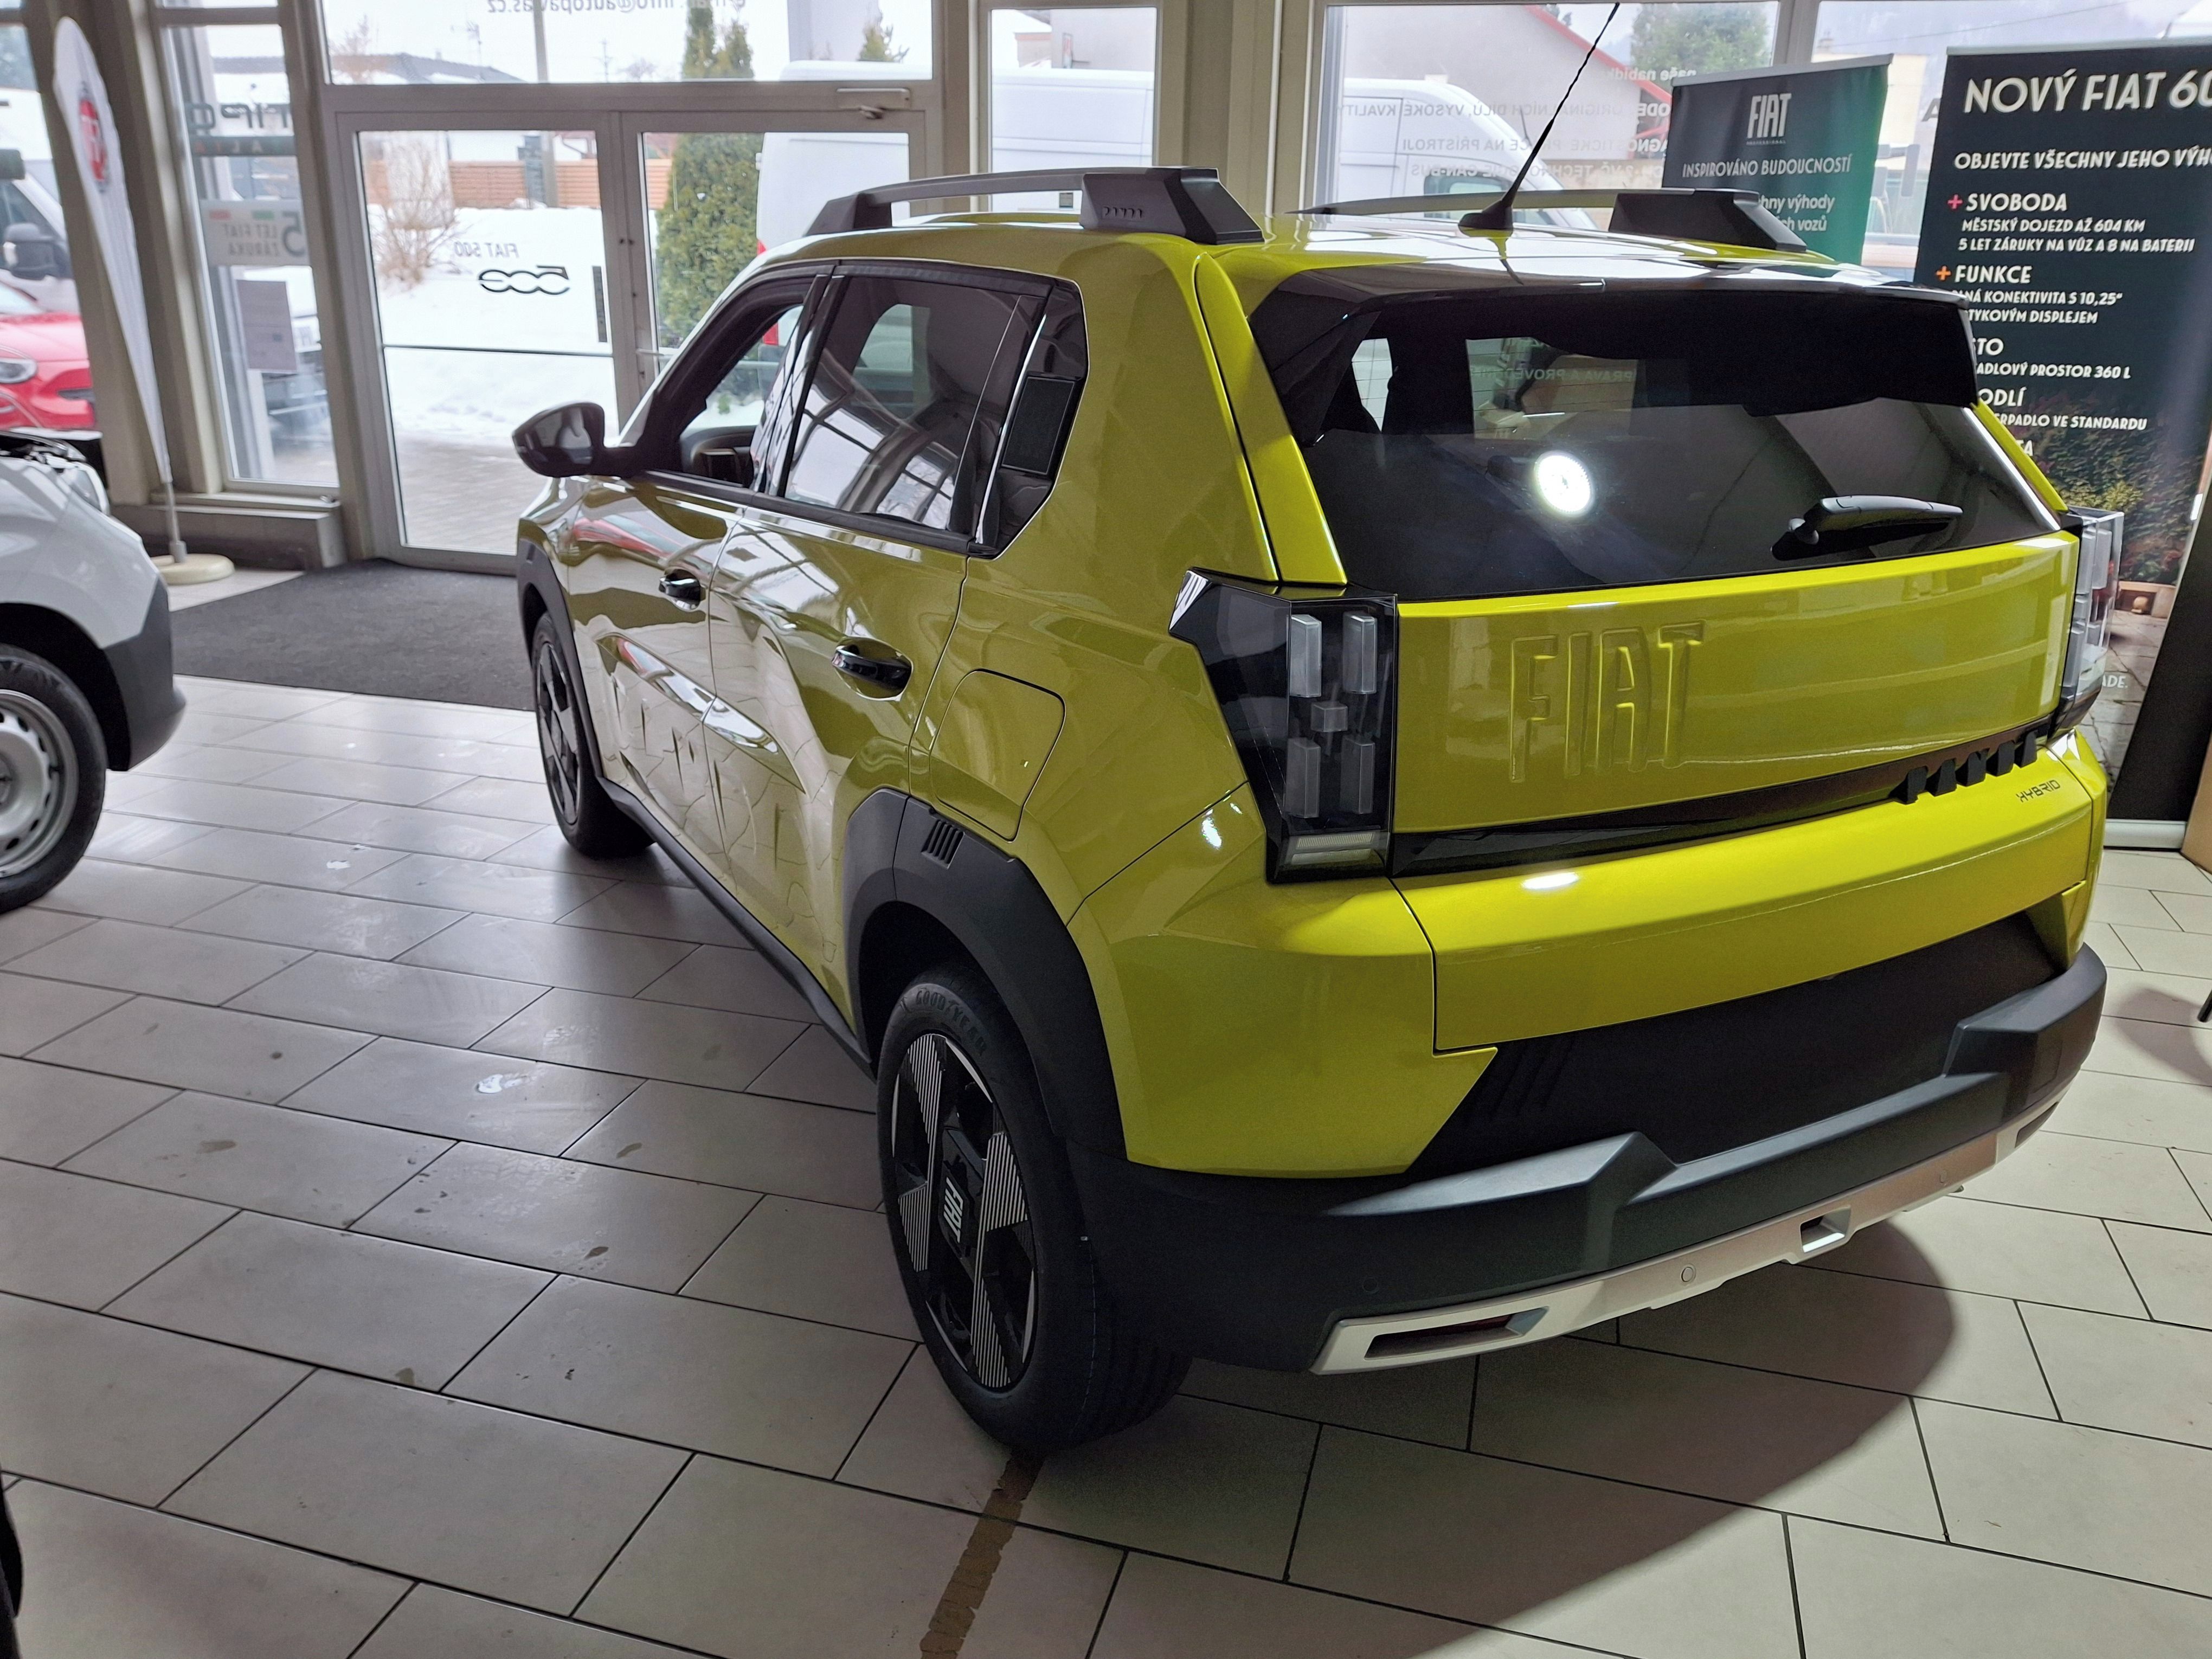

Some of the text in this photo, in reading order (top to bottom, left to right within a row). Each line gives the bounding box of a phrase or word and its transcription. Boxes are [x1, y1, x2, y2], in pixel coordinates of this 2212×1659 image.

[1964, 68, 2077, 113] NOVÝ
[2082, 70, 2166, 111] FIAT
[1747, 93, 1793, 139] FIAT
[1682, 158, 1758, 177] INSPIROVÁNO
[1761, 153, 1852, 175] BUDOUCNOSTÍ
[1954, 145, 2212, 170] OBJEVTE VŠECHNY JEHO VÝH
[1787, 192, 1836, 214] výhody
[1965, 193, 2068, 212] SVOBODA
[1798, 214, 1827, 231] vozů
[1962, 216, 2145, 232] MĚSTSKÝ DOJEZD AŽ 604 KM
[1958, 239, 1968, 251] 5
[1971, 239, 1992, 251] LET
[1993, 236, 2044, 251] ZÁRUKY
[2046, 239, 2063, 251] NA
[2095, 239, 2105, 251] A
[2107, 239, 2118, 252] 8
[2120, 239, 2139, 252] NA
[2141, 239, 2195, 253] BATERII
[1954, 265, 2033, 284] FUNKCE
[1984, 291, 2067, 305] KONEKTIVITA
[2068, 292, 2077, 305] S
[1964, 307, 2098, 324] TYKOVÝM DISPLEJEM
[1977, 361, 2131, 379] ADLOVÝ PROSTOR 360 L
[1978, 387, 2027, 407] ODLÍ
[2053, 415, 2069, 428] VE
[2070, 415, 2147, 430] STANDARDU
[1509, 619, 1706, 783] FIAT
[2015, 779, 2061, 803] HYBRID
[943, 1176, 963, 1243] FIAT
